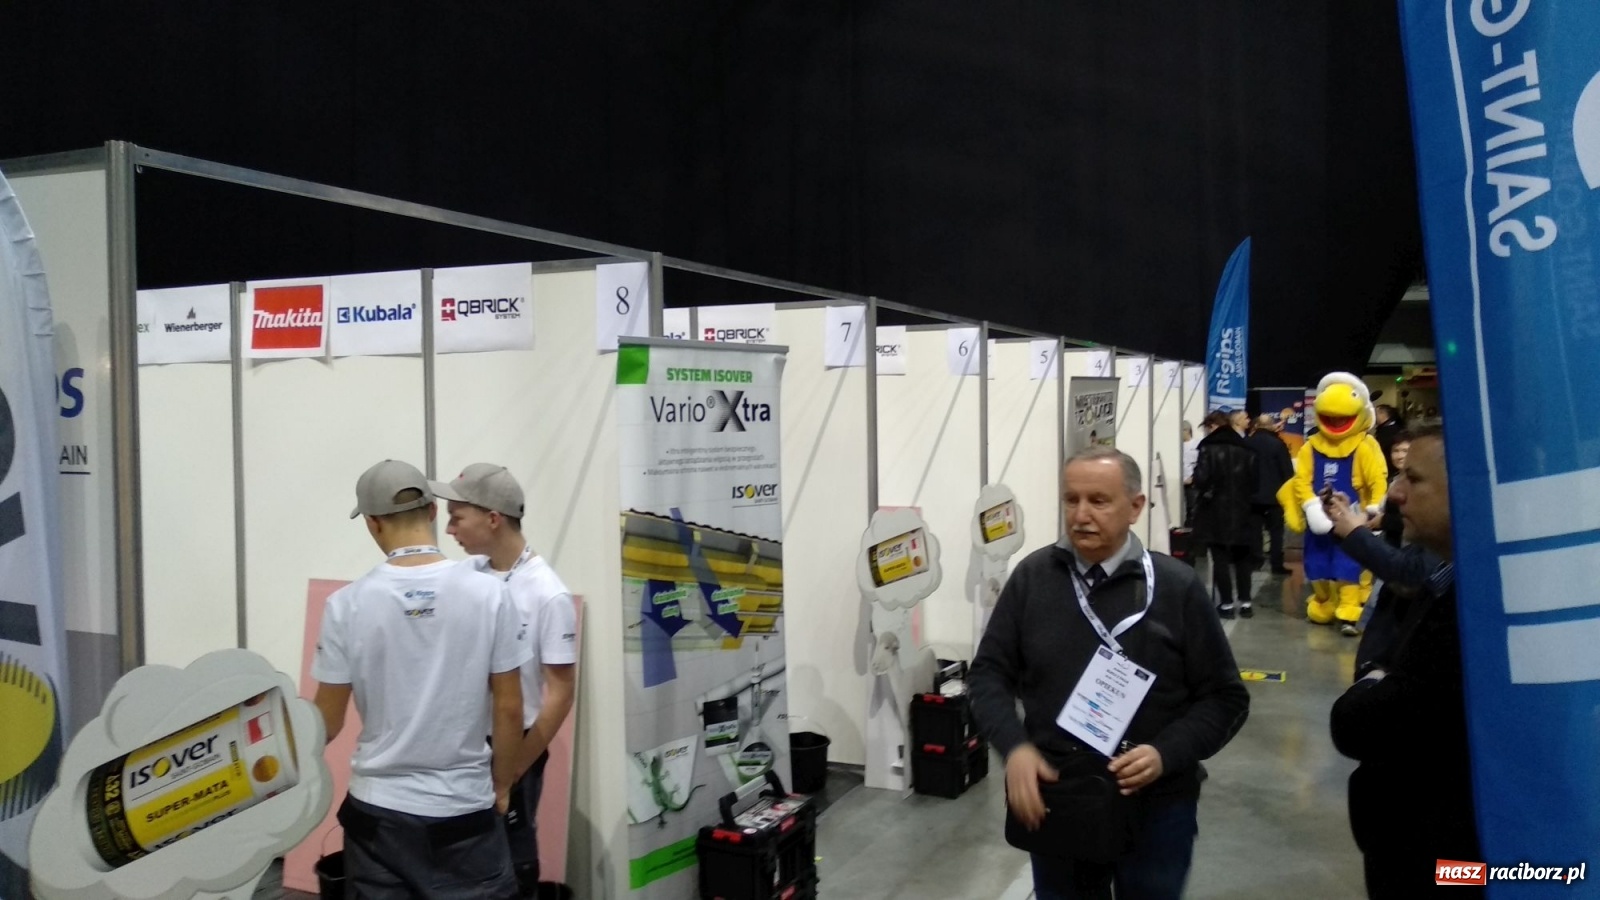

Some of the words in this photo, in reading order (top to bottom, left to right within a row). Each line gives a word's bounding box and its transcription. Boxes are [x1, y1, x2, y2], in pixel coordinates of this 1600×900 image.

[457, 297, 519, 317] QBRICK
[615, 286, 630, 315] 8
[164, 321, 223, 333] Wienerberger
[716, 328, 765, 342] QBRICK
[840, 322, 852, 342] 7
[958, 340, 969, 357] 6
[1039, 351, 1048, 364] 5
[1094, 359, 1103, 371] 4
[1216, 328, 1235, 395] Rigips
[666, 367, 711, 382] SYSTEM
[713, 369, 753, 383] ISOVER
[1135, 365, 1142, 376] 3
[1168, 368, 1176, 378] 2
[59, 445, 88, 465] AIN
[146, 780, 230, 823] SUPER-MATA
